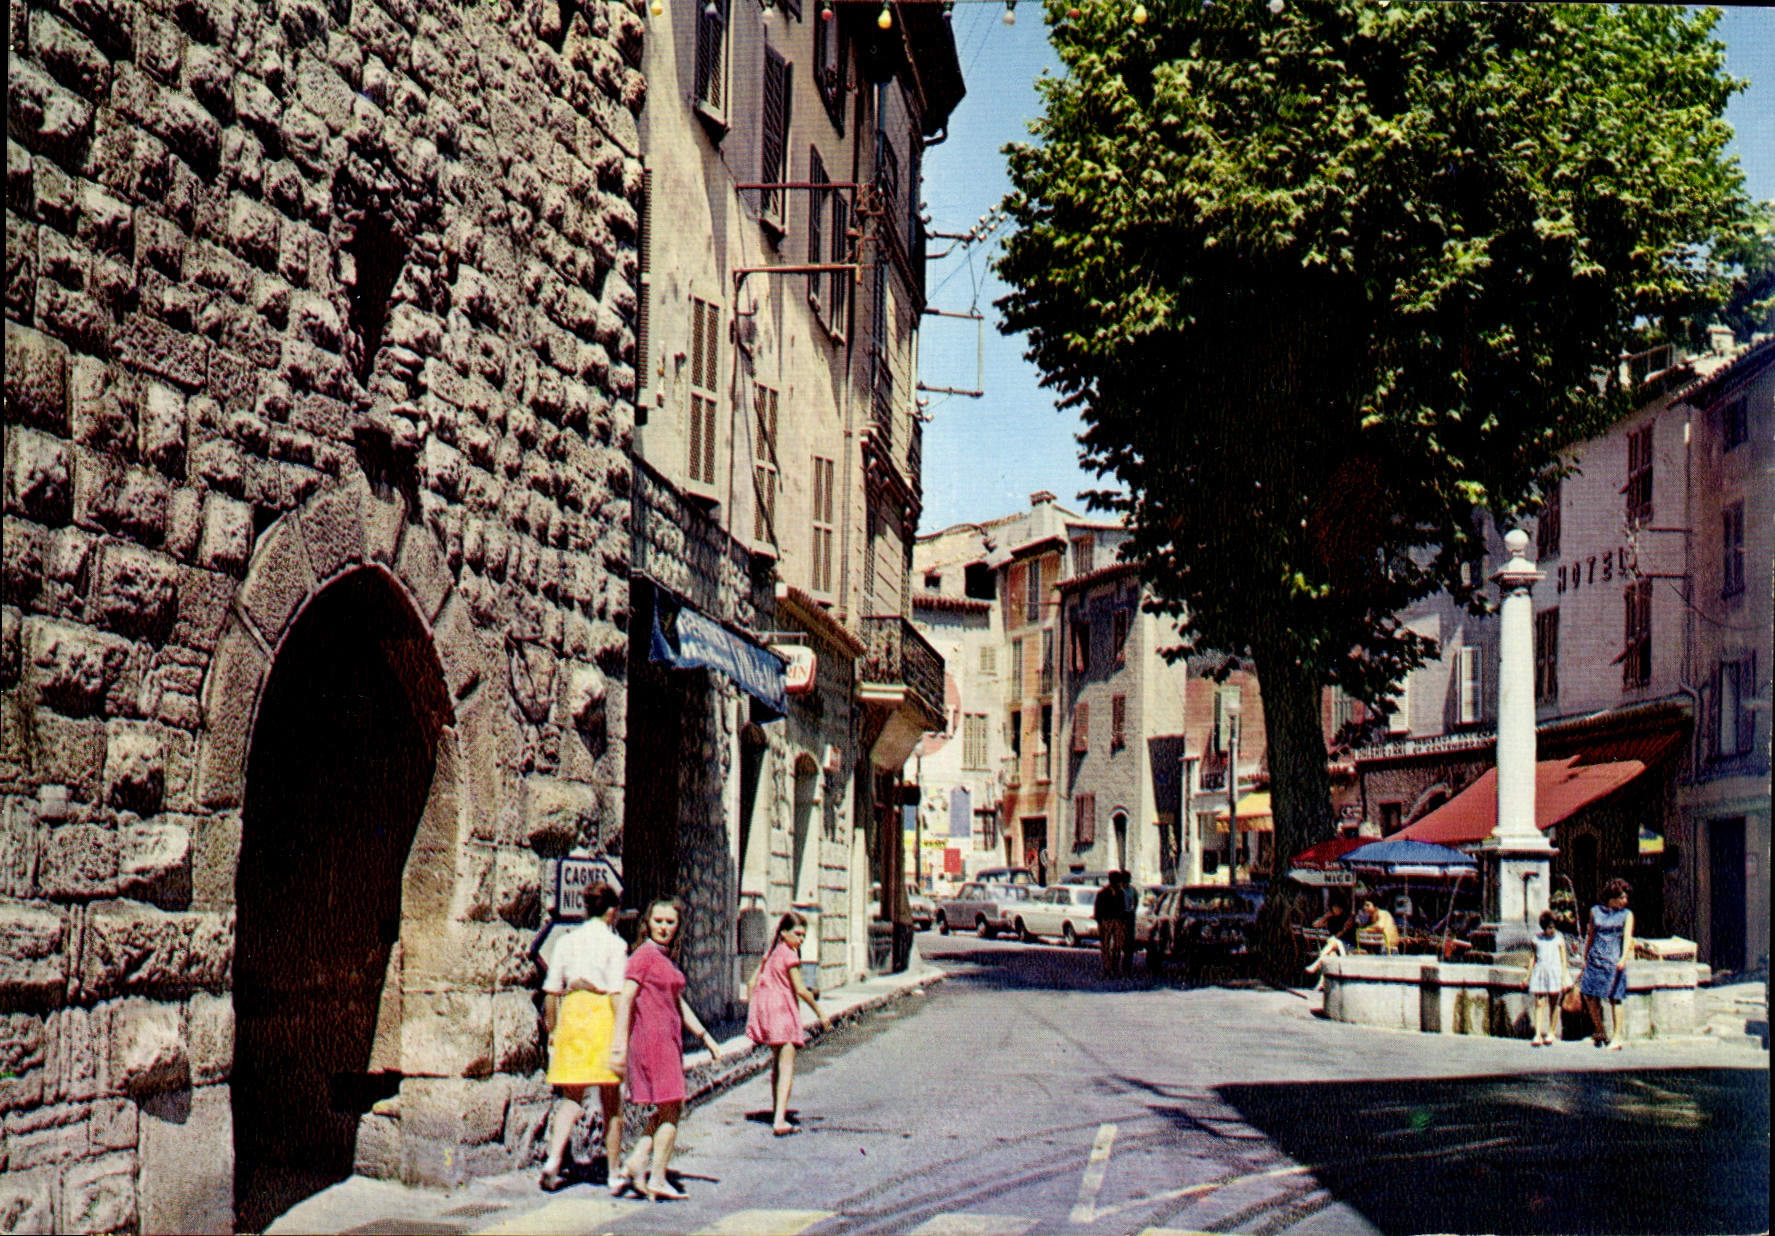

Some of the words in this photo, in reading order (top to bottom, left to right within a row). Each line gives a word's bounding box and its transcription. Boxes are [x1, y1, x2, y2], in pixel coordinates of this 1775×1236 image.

[1557, 546, 1627, 595] HOTEL
[564, 866, 608, 886] CAGNES
[563, 889, 583, 910] NIC
